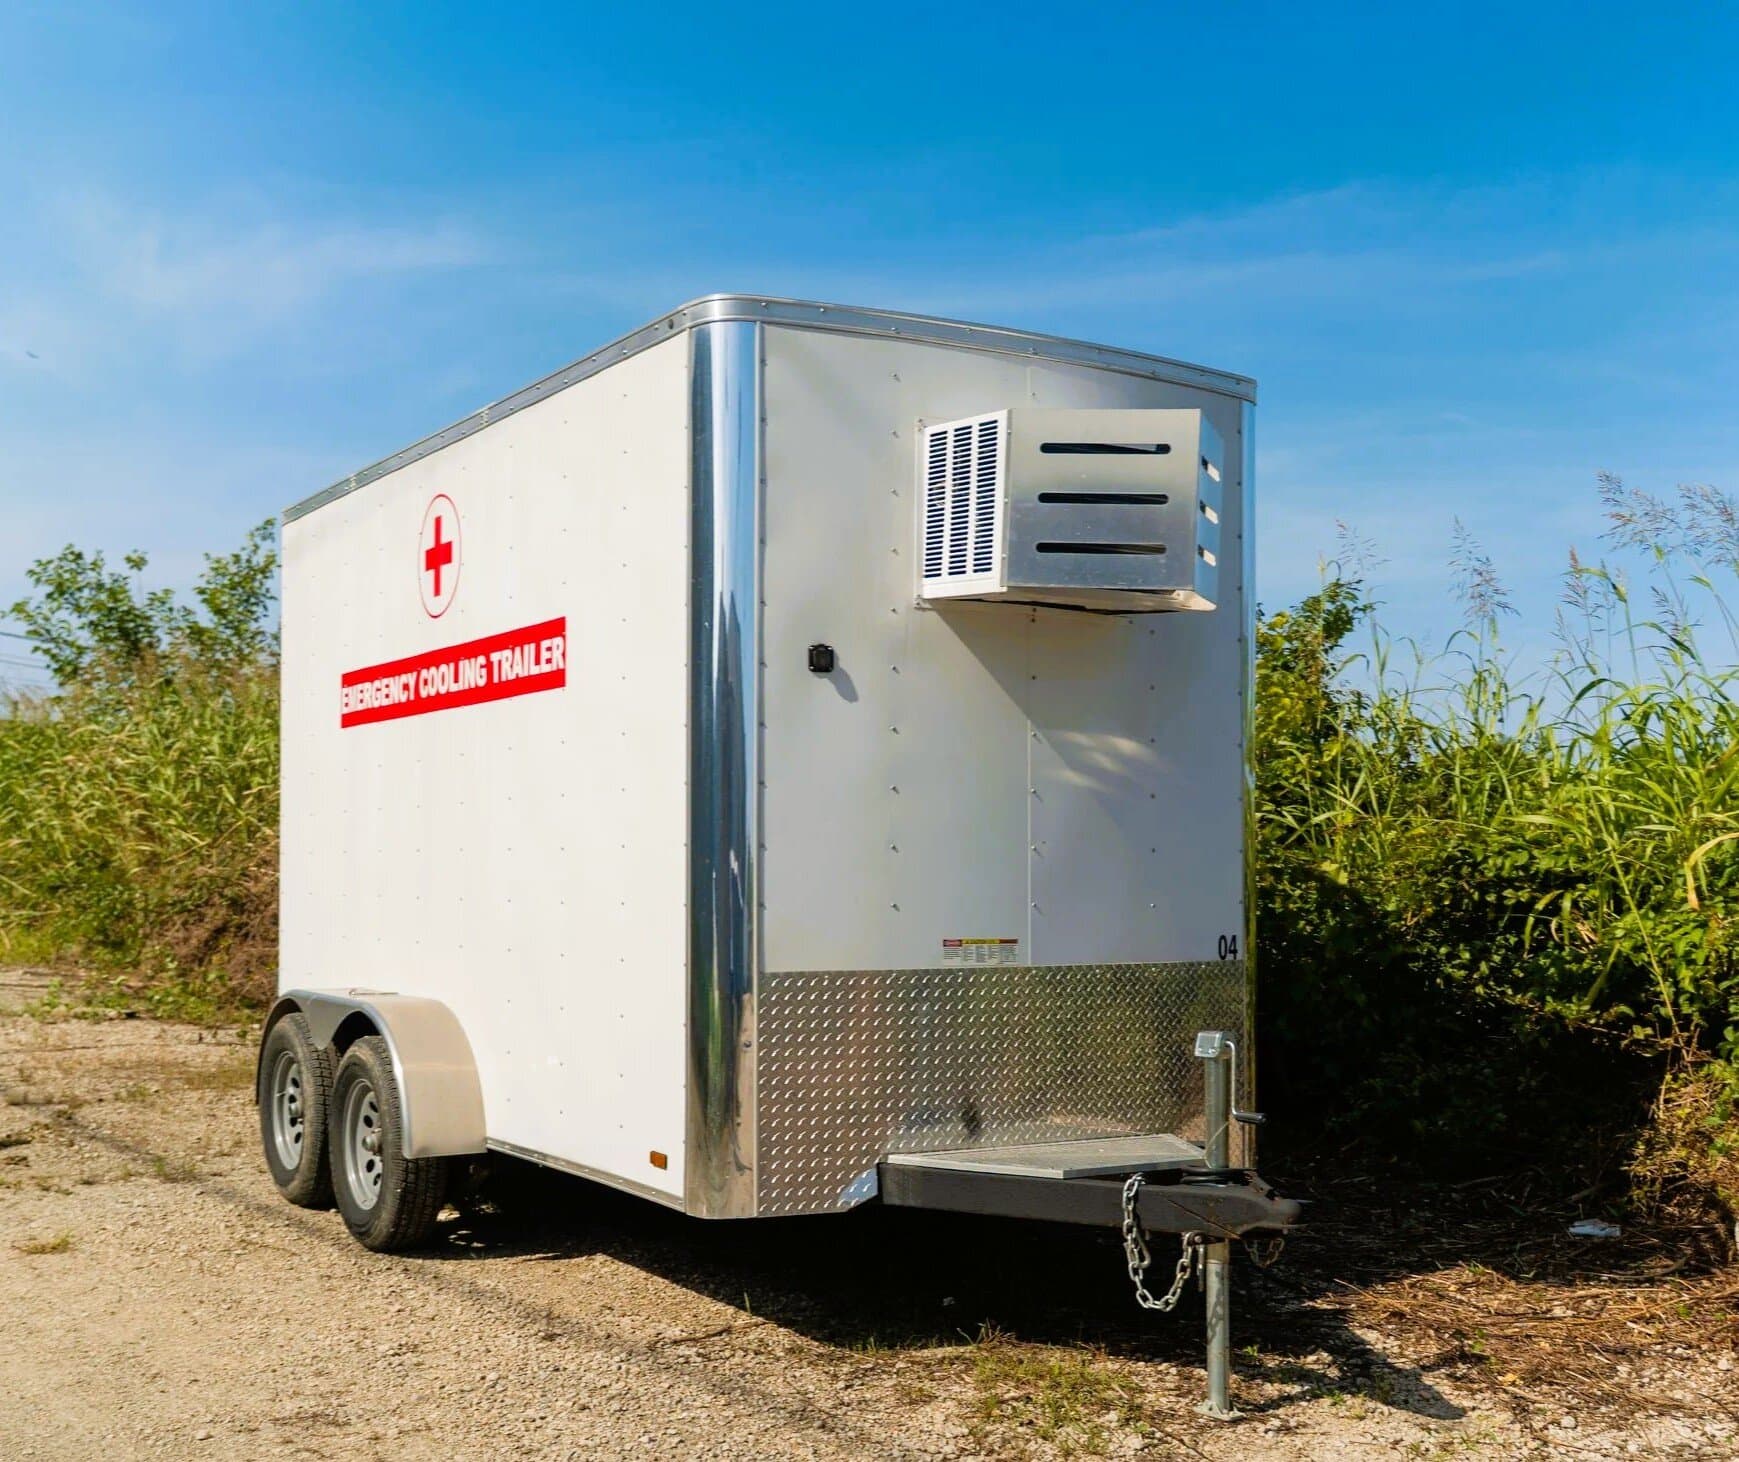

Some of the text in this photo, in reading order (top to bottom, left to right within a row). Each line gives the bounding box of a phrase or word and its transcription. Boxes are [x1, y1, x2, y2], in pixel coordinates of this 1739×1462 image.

[341, 635, 565, 714] EMERGENCY COOLING TRAILER
[1218, 934, 1238, 960] 04
